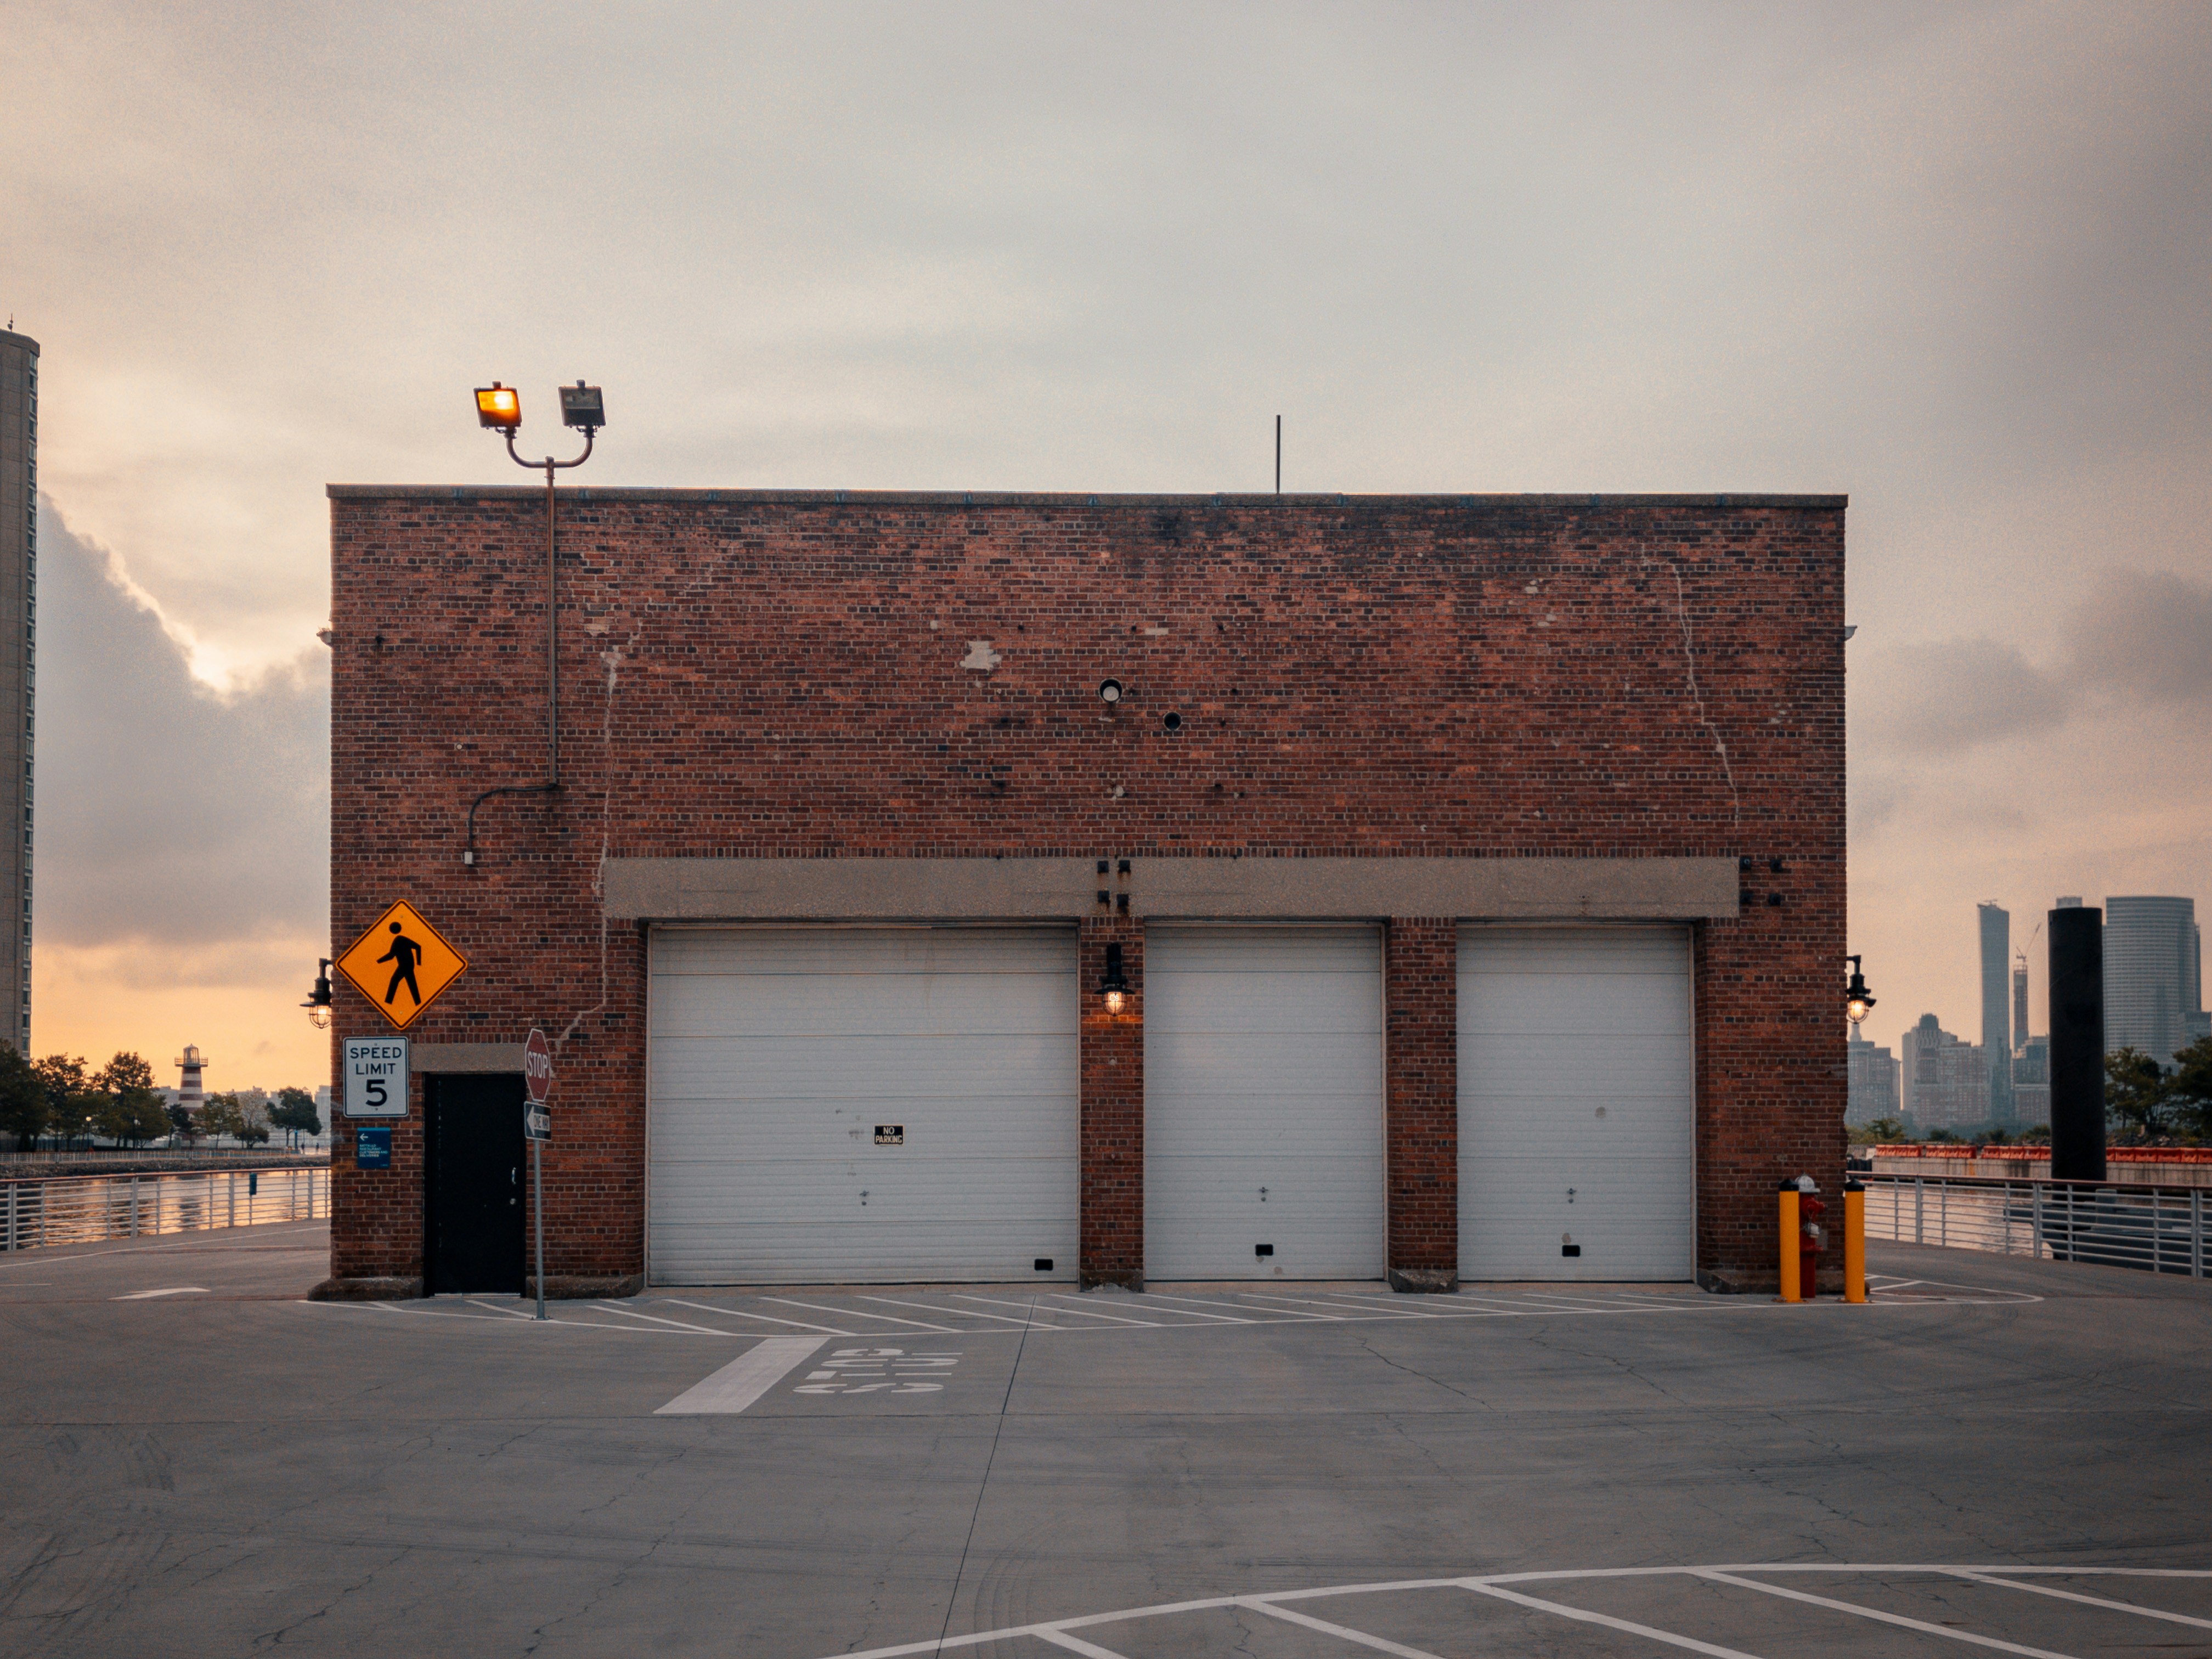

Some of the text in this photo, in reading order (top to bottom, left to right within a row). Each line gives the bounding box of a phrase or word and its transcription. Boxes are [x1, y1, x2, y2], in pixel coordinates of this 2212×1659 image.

[350, 1047, 402, 1059] SPEED
[356, 1063, 396, 1075] LIMIT
[527, 1051, 548, 1079] STOP
[365, 1079, 387, 1107] 5
[883, 1126, 895, 1135] NO
[875, 1135, 902, 1143] PARKING
[793, 1348, 963, 1393] STOP
